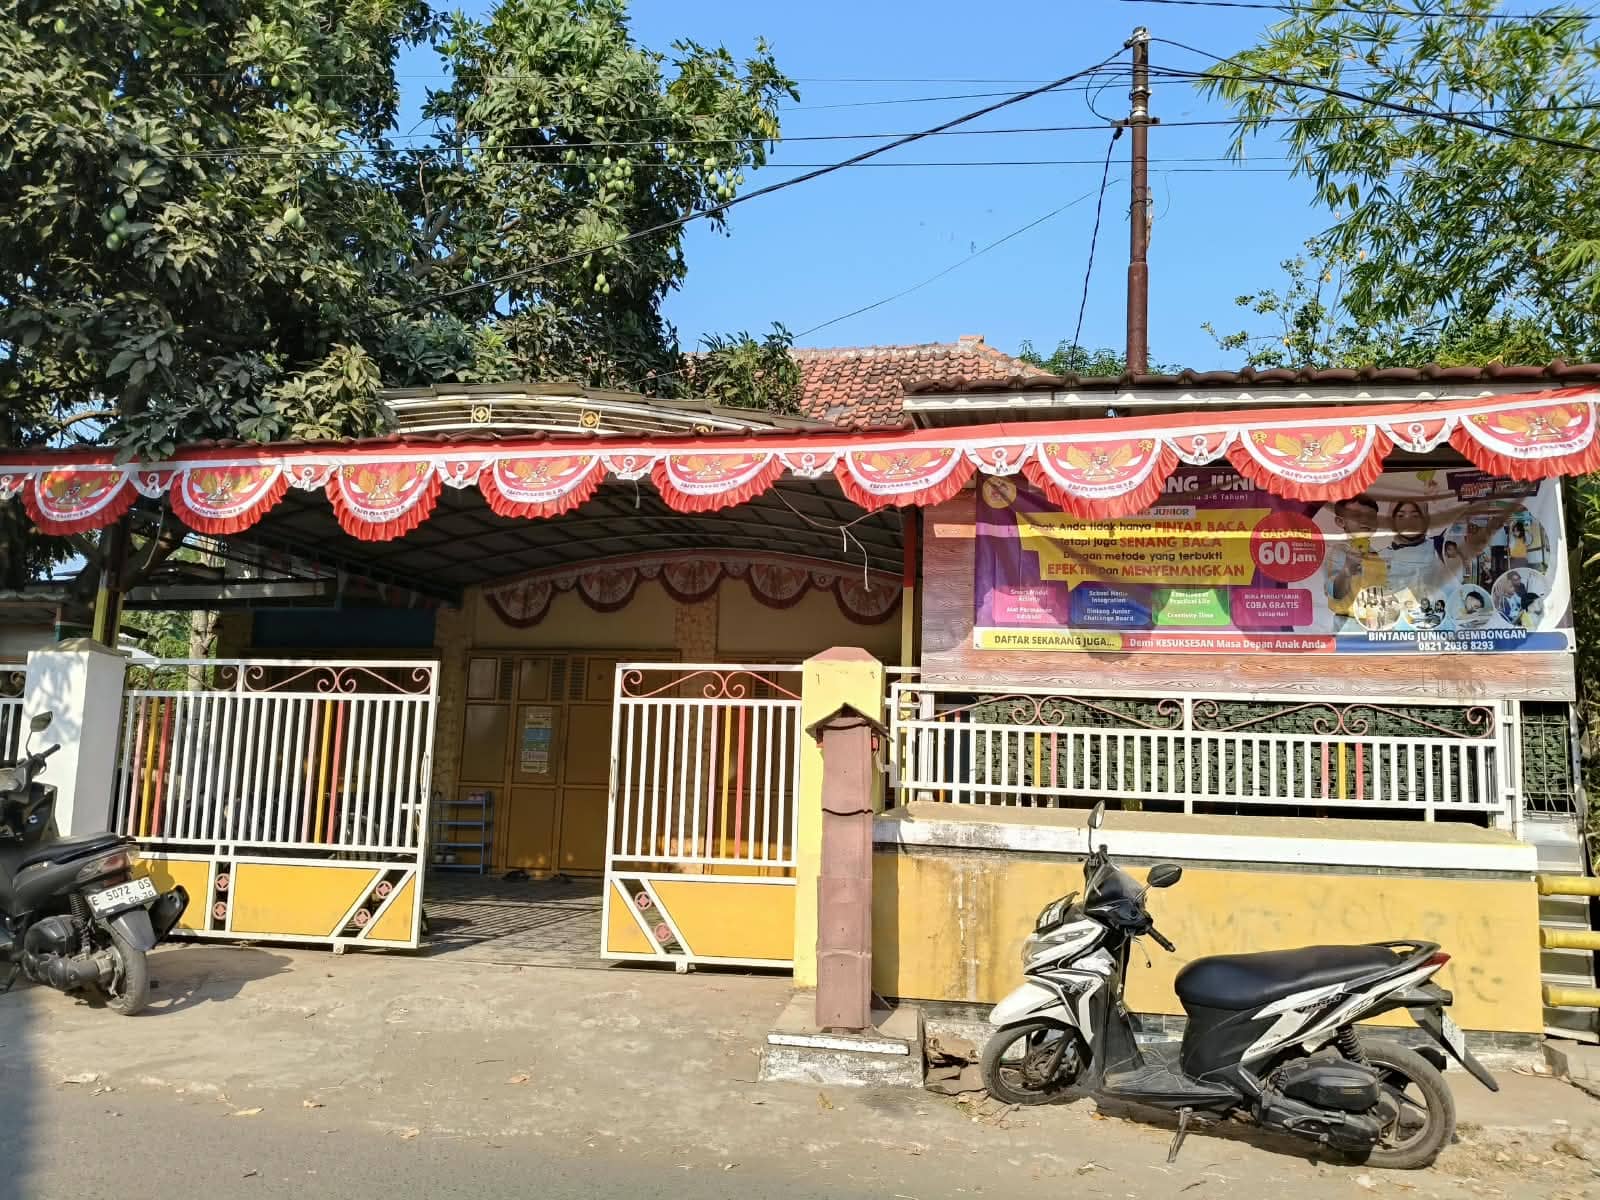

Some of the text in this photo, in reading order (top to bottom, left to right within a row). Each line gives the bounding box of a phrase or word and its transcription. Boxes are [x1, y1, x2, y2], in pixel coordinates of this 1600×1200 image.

[1211, 474, 1268, 491] JUNI
[1153, 508, 1189, 516] JUNIOR
[1060, 522, 1086, 531] Anda
[1091, 521, 1115, 531] tidak
[1120, 522, 1151, 532] hanya
[1155, 521, 1202, 533] PINTAR
[1207, 521, 1246, 532] BACA
[1093, 538, 1117, 548] juga
[1120, 537, 1177, 548] SENANG
[1183, 538, 1222, 547] BACA
[1104, 551, 1145, 560] metode
[1150, 552, 1175, 562] yang
[1179, 551, 1222, 560] terbukti
[1259, 541, 1290, 565] 60
[1122, 564, 1244, 576] MENYENANGKAN
[994, 635, 1115, 648] DAFTAR SEKARANG JUGA...
[1368, 630, 1527, 642] BINTANG JUNIOR GEMBONGAN
[1156, 638, 1214, 648] KESUKSESAN
[1217, 639, 1241, 648] Masa
[1244, 639, 1273, 650] Depan
[1275, 639, 1298, 648] Anak
[1301, 639, 1326, 648] Anda
[1418, 641, 1494, 650] 0821 2036 8293
[91, 895, 99, 906] E
[106, 885, 131, 901] 5072
